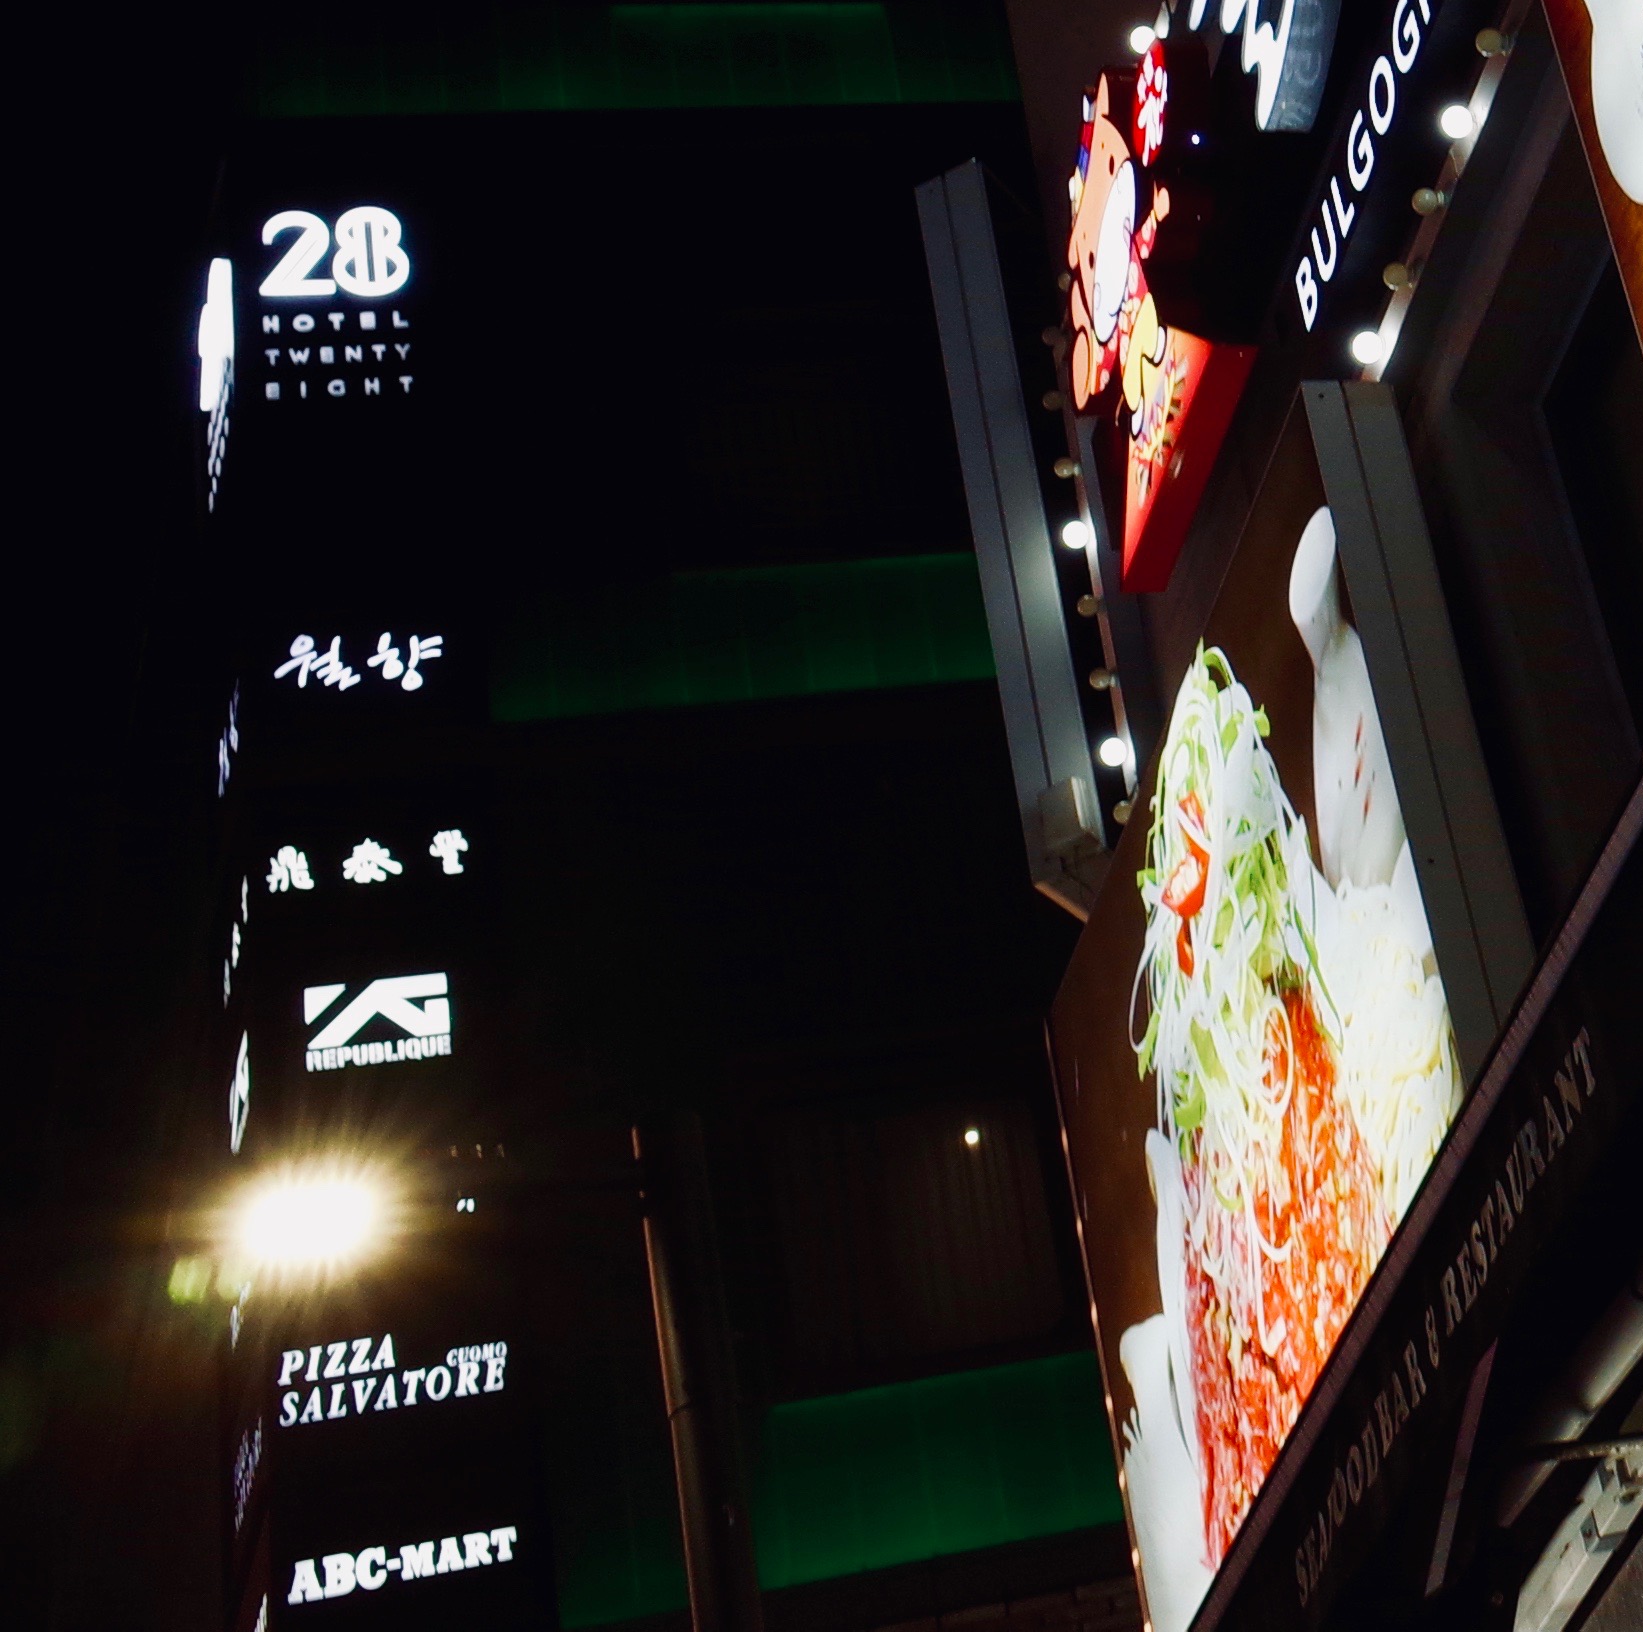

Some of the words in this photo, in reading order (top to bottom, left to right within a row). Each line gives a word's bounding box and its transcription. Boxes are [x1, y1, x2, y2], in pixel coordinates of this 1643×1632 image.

[258, 205, 411, 297] 28
[262, 311, 409, 334] HOTEL
[264, 343, 411, 366] TWENTY
[265, 375, 414, 400] EIGHT
[305, 1034, 453, 1072] REPUBLIQUE
[1440, 1026, 1598, 1339] RESTAURANT
[278, 1333, 396, 1386] PIZZA
[446, 1341, 507, 1368] CUOMO
[279, 1358, 506, 1427] SALVATORE
[287, 1525, 518, 1605] ABC-MART
